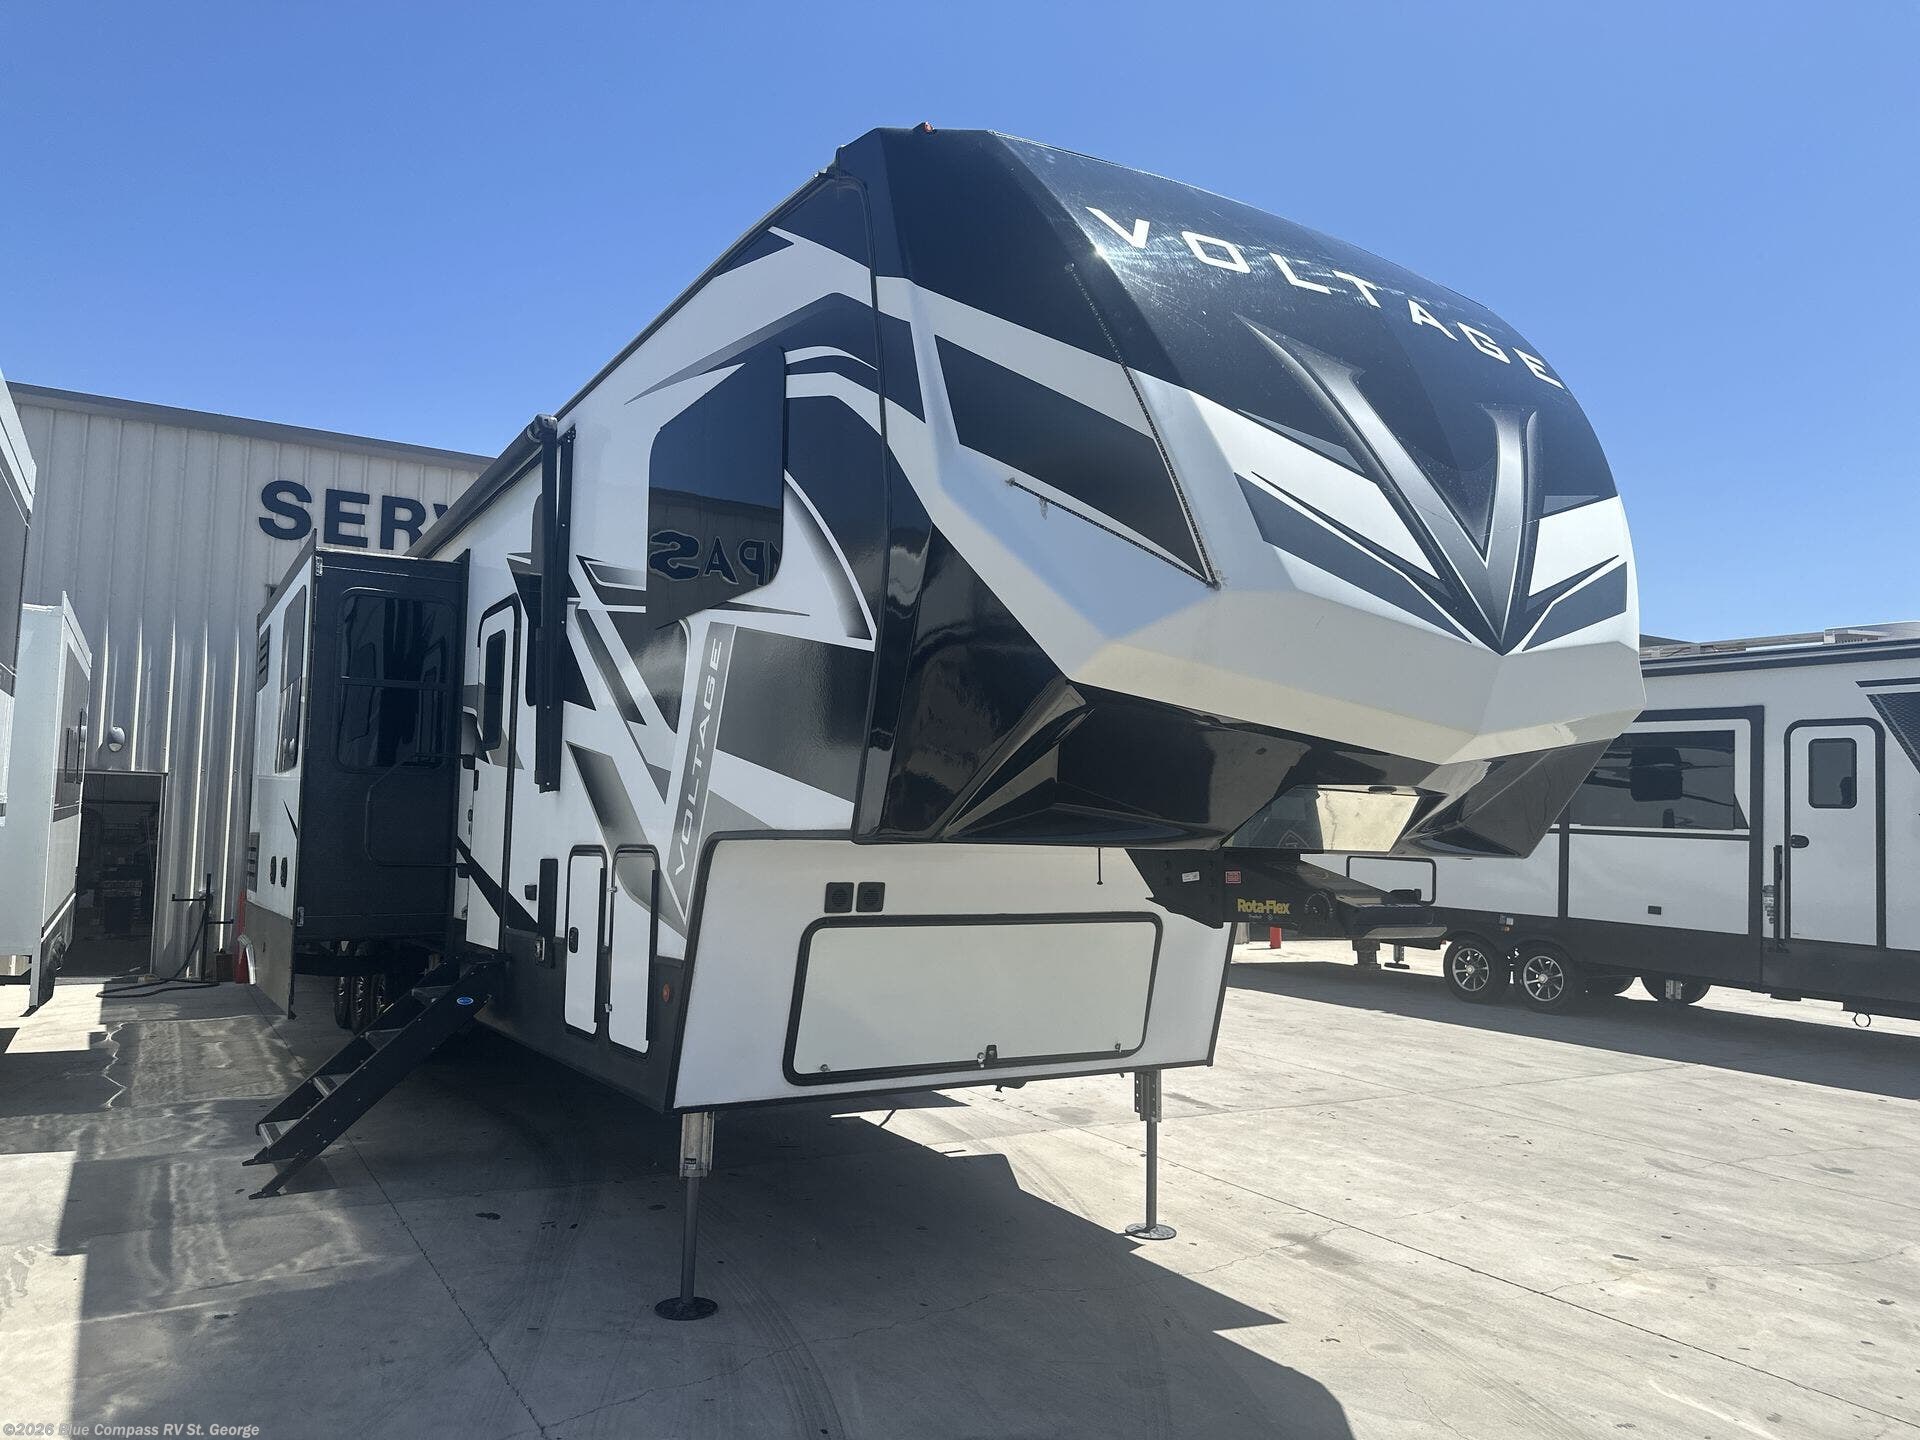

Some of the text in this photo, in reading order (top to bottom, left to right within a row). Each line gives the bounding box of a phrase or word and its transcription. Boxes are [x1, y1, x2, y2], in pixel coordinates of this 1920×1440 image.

[1085, 206, 1564, 390] VOLTAGE
[258, 479, 451, 550] SER
[675, 638, 723, 876] VOLTAGE
[1237, 898, 1291, 915] Rota-Flex
